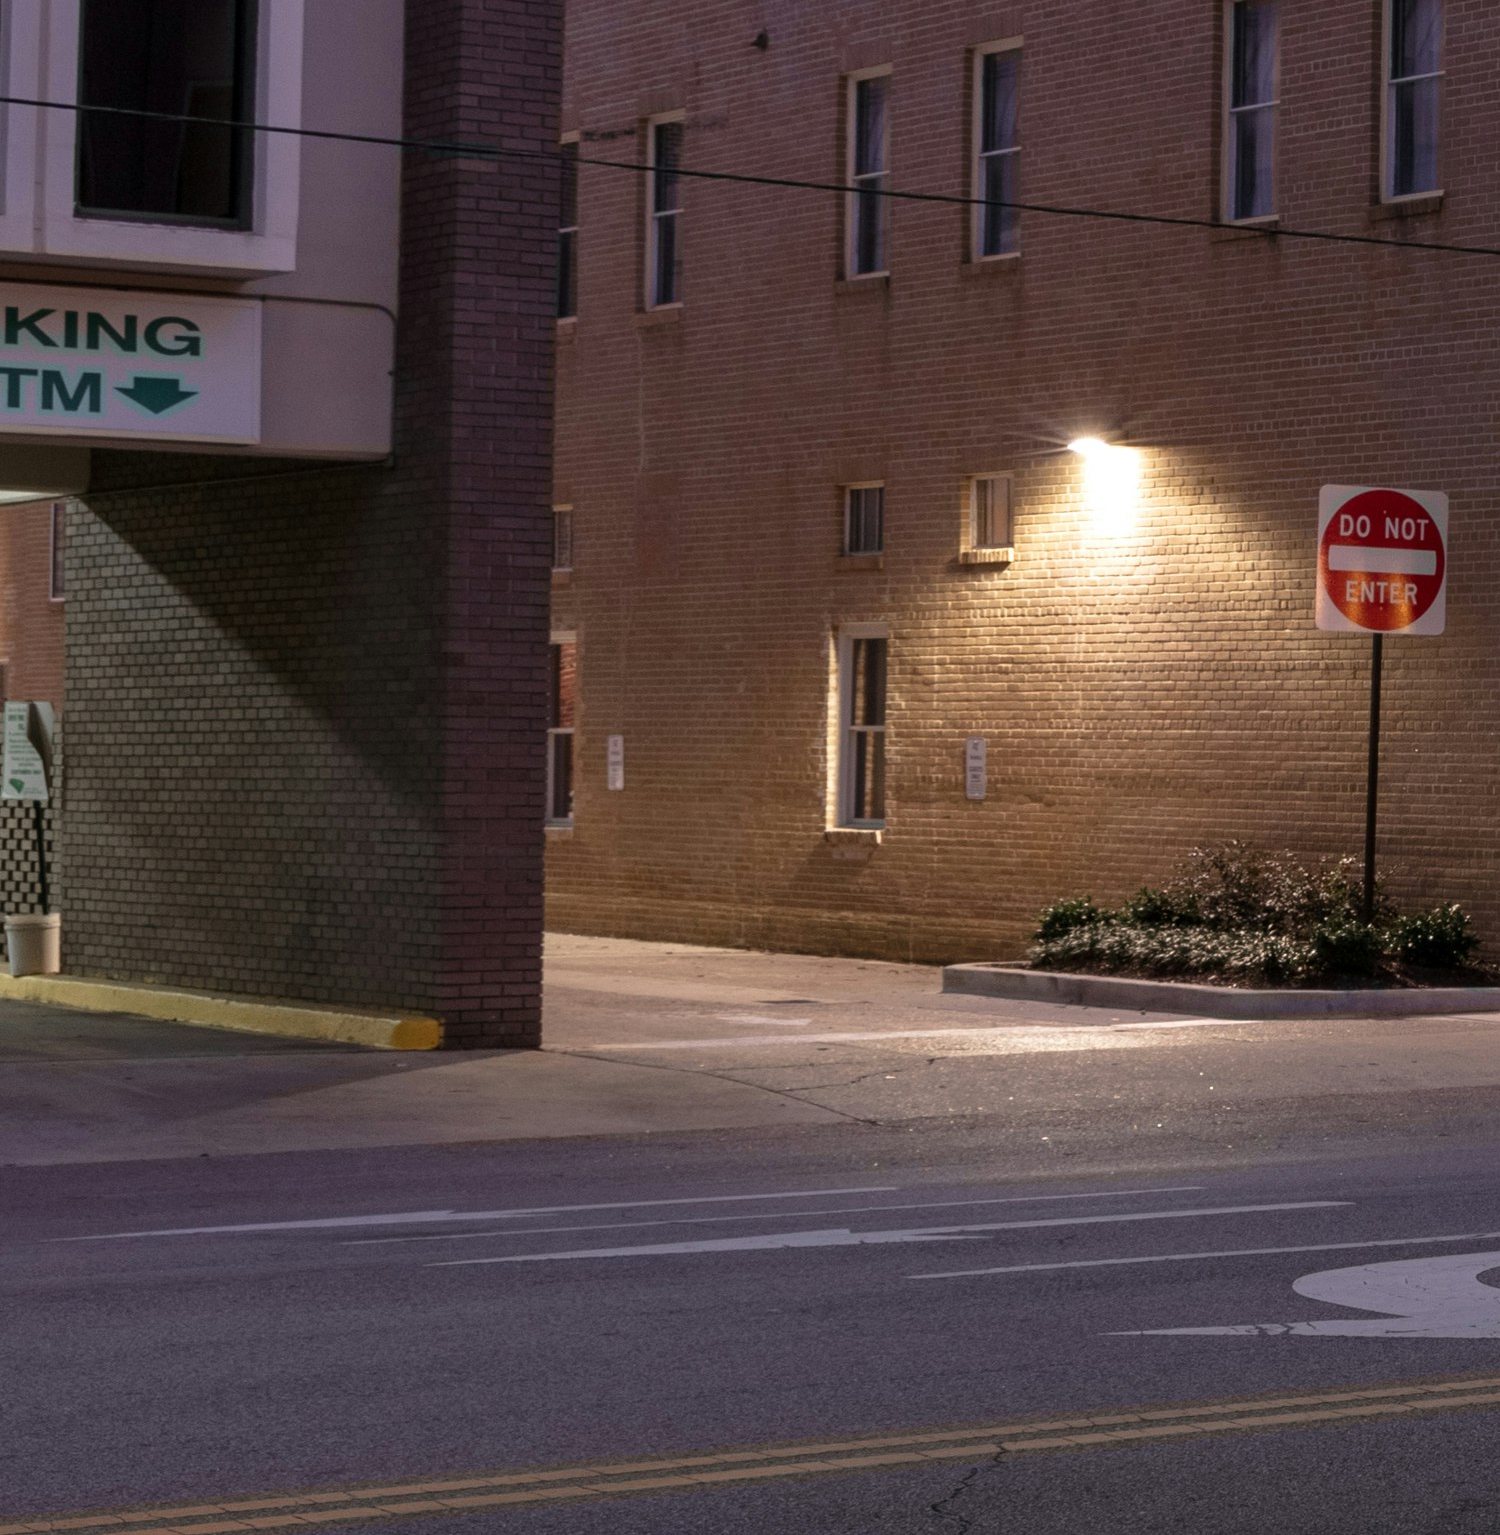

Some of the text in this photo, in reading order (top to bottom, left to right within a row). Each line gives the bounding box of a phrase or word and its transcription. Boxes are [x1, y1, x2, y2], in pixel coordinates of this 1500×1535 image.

[4, 306, 200, 356] KING
[1339, 514, 1429, 541] DO NOT
[1345, 580, 1418, 605] ENTER
